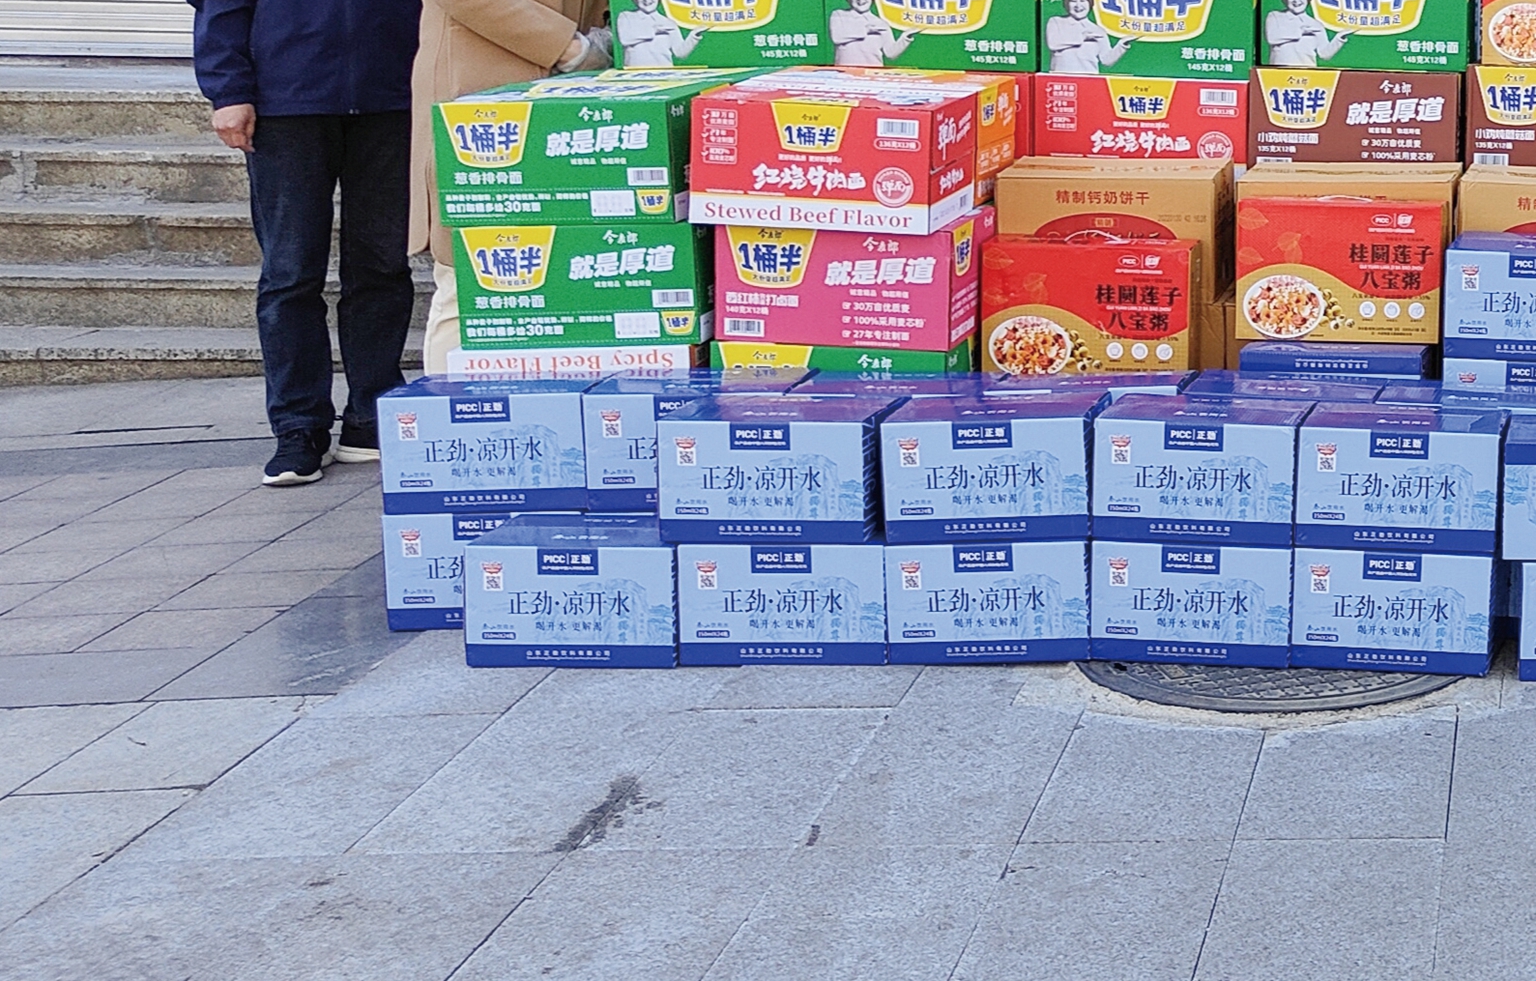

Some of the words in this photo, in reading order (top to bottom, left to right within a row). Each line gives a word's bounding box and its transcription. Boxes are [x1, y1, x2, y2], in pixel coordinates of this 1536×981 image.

[690, 9, 757, 23] 大份量超满足
[902, 12, 968, 25] 大份量超满足
[1336, 12, 1401, 27] 大份量超满足
[1120, 19, 1187, 32] 大份量超满足
[753, 34, 819, 48] 葱香排骨面
[964, 39, 1029, 54] 葱香排骨面
[1397, 40, 1459, 55] 葱香排骨面
[1181, 47, 1245, 63] 葱香排骨面
[1118, 96, 1164, 114] 1桶半
[1269, 88, 1326, 115] 1桶半
[1346, 97, 1445, 125] 就是厚道
[455, 121, 519, 154] 1桶半
[546, 122, 649, 157] 就是厚道
[784, 125, 838, 146] 1桶半
[1090, 130, 1191, 158] 红烧牛肉面
[454, 172, 523, 185] 葱香排骨面
[752, 163, 866, 196] 红烧牛肉面
[1056, 190, 1150, 205] 精制钙奶饼干
[705, 202, 782, 222] Stewed
[790, 205, 838, 224] Beef
[842, 209, 913, 229] Flavor
[476, 246, 542, 277] 1桶半
[569, 245, 676, 280] 就是厚道
[738, 243, 804, 273] 1桶半
[1514, 260, 1533, 268] PICC
[825, 256, 937, 287] 就是厚道
[1360, 271, 1421, 290] 八宝粥
[475, 295, 545, 309] 葱香排骨面
[1109, 312, 1169, 332] 八宝粥
[466, 356, 541, 370] Flavor
[551, 354, 600, 368] Beef
[610, 351, 674, 368] Spicy
[543, 554, 565, 564] PICC
[757, 554, 779, 562] PICC
[959, 553, 980, 561] PICC
